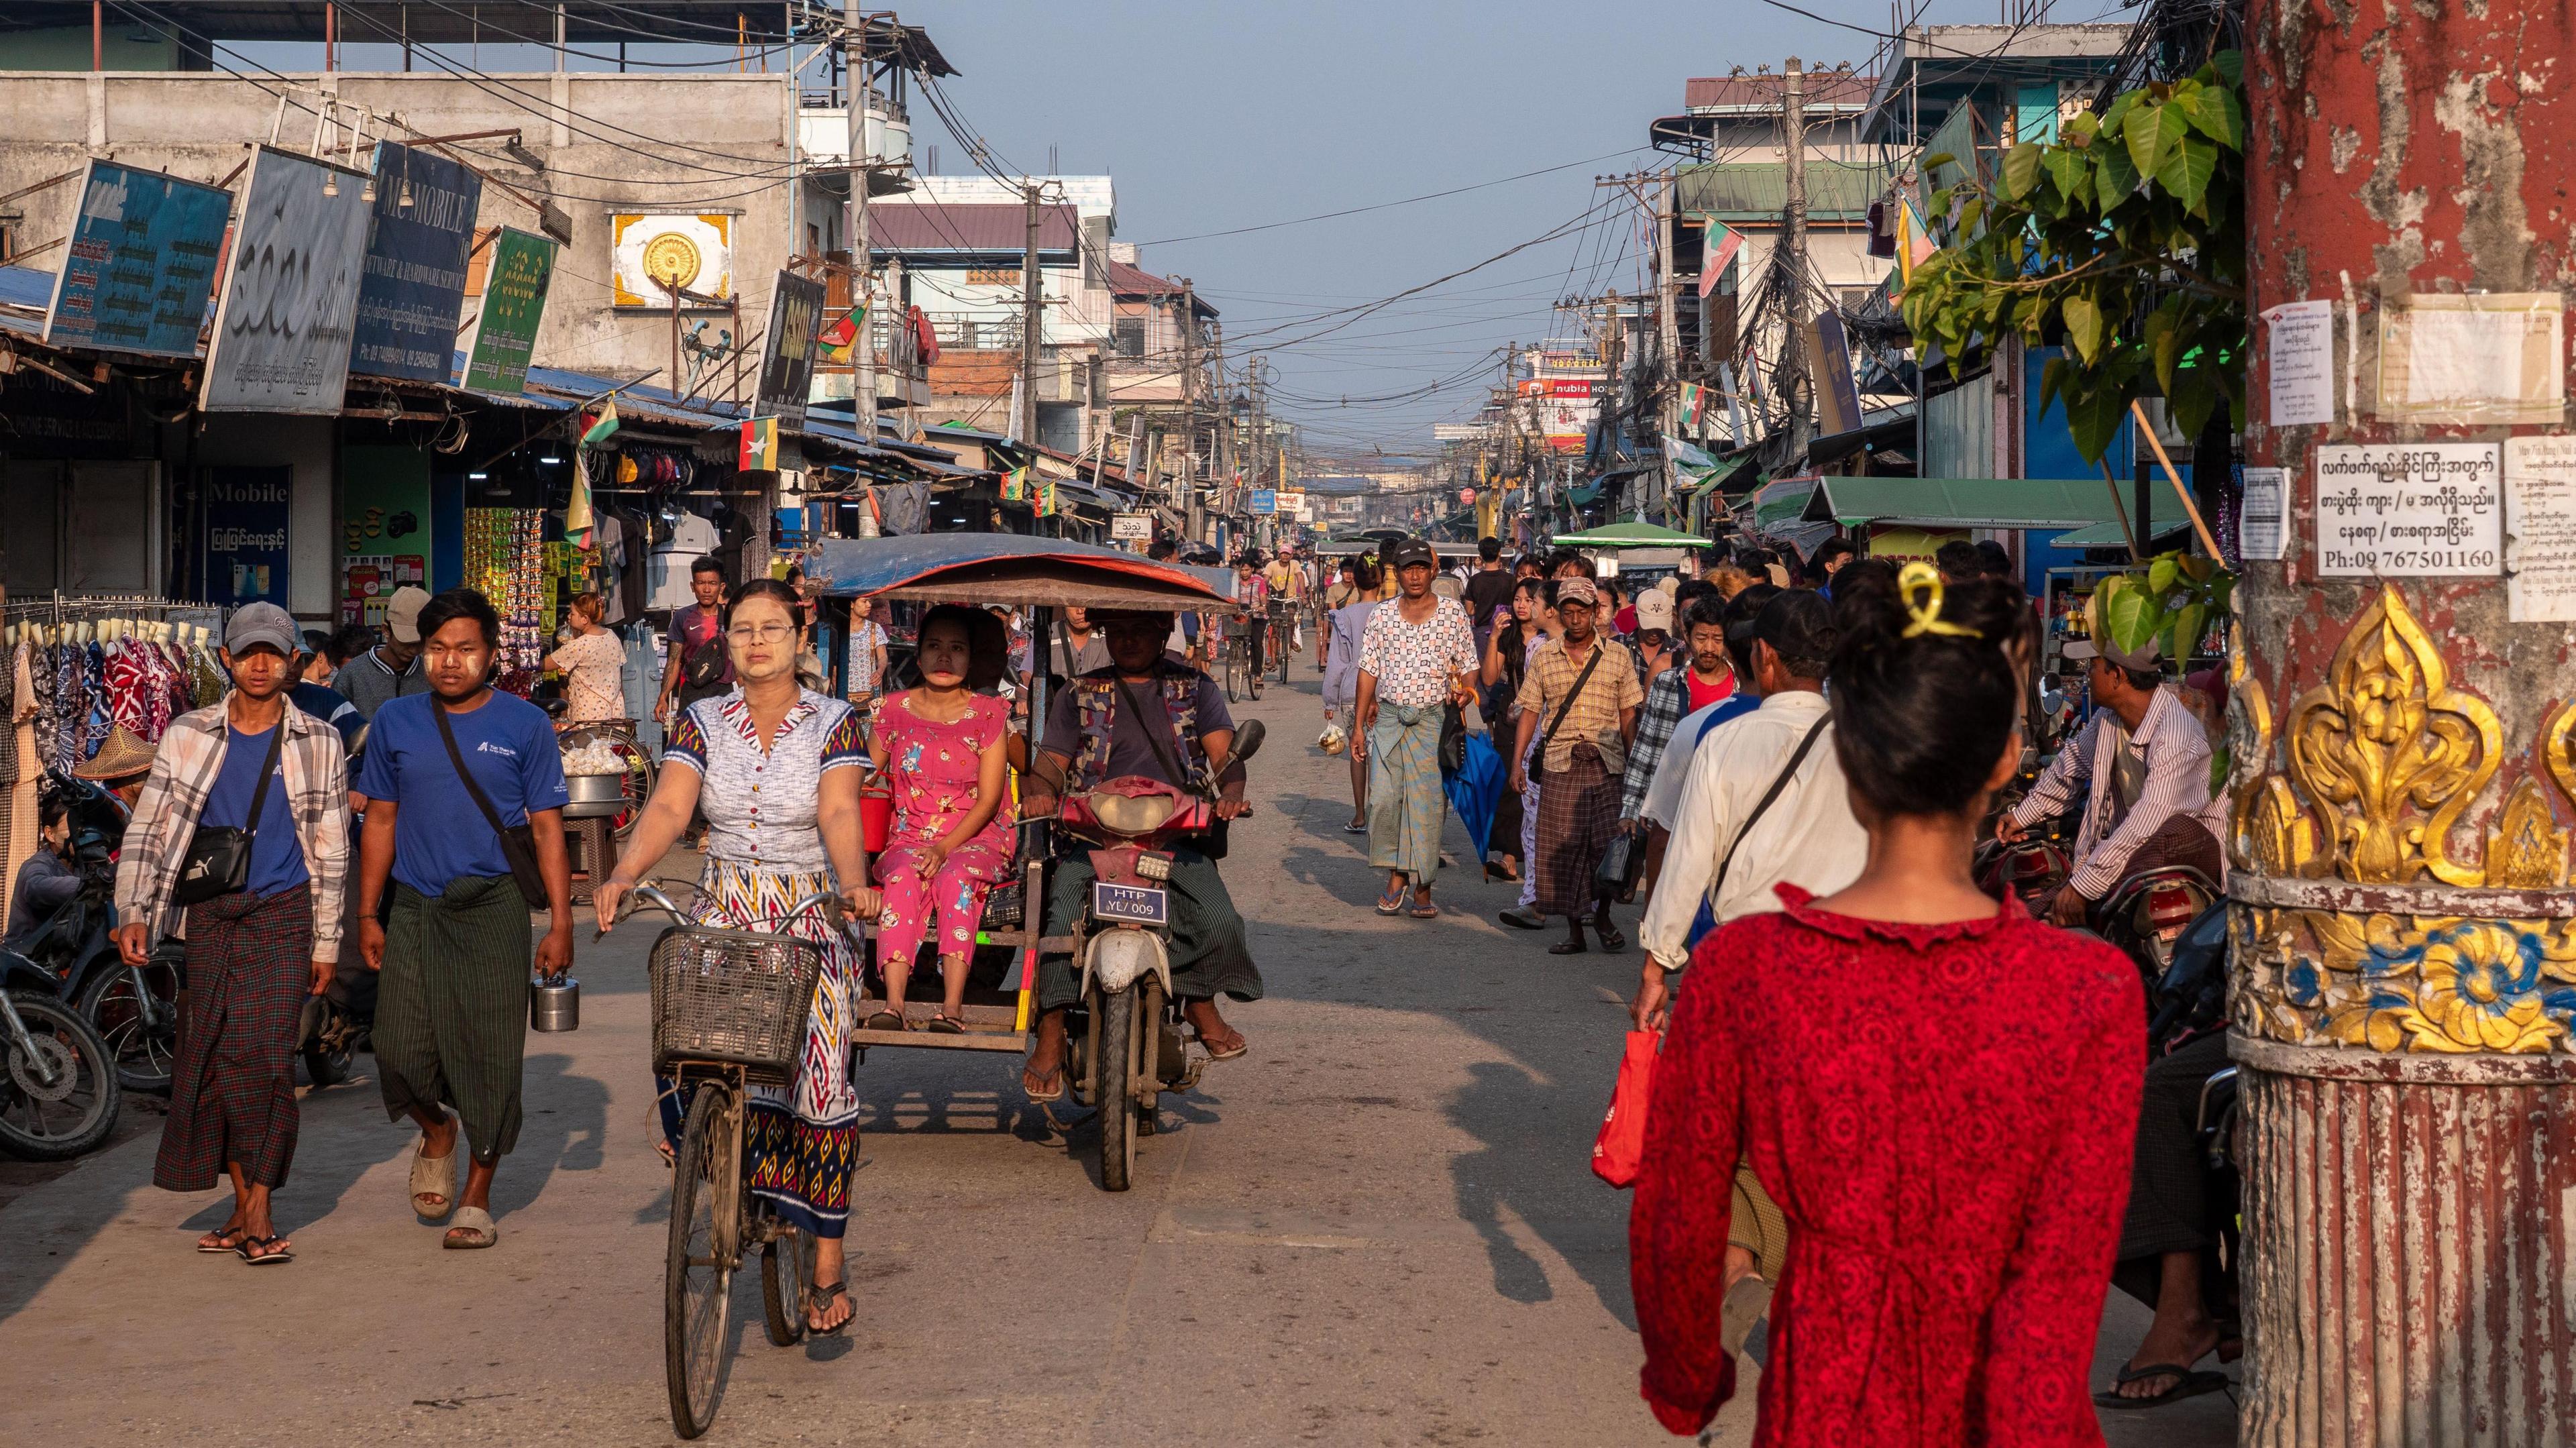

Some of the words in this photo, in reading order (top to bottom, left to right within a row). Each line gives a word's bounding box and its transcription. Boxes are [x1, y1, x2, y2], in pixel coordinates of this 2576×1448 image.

[410, 182, 467, 233] MOBILE
[363, 255, 398, 278] OFTWARE
[396, 260, 404, 280] &
[404, 262, 441, 286] HARDWARE
[440, 270, 466, 292] SERVICE
[370, 344, 379, 361] 09
[407, 350, 414, 366] 09
[1556, 384, 1587, 393] nubia
[212, 483, 288, 502] Mobile
[2320, 487, 2363, 516] စားပွဲထိုး
[2366, 494, 2393, 515] ကျား
[2406, 496, 2415, 507] မ
[211, 527, 285, 551] ပြုပြင်ရေးနှင့်
[2339, 524, 2377, 545] နေစရာ
[2381, 550, 2494, 568] 767501160
[1114, 889, 1146, 899] HTP
[1132, 903, 1154, 915] 009
